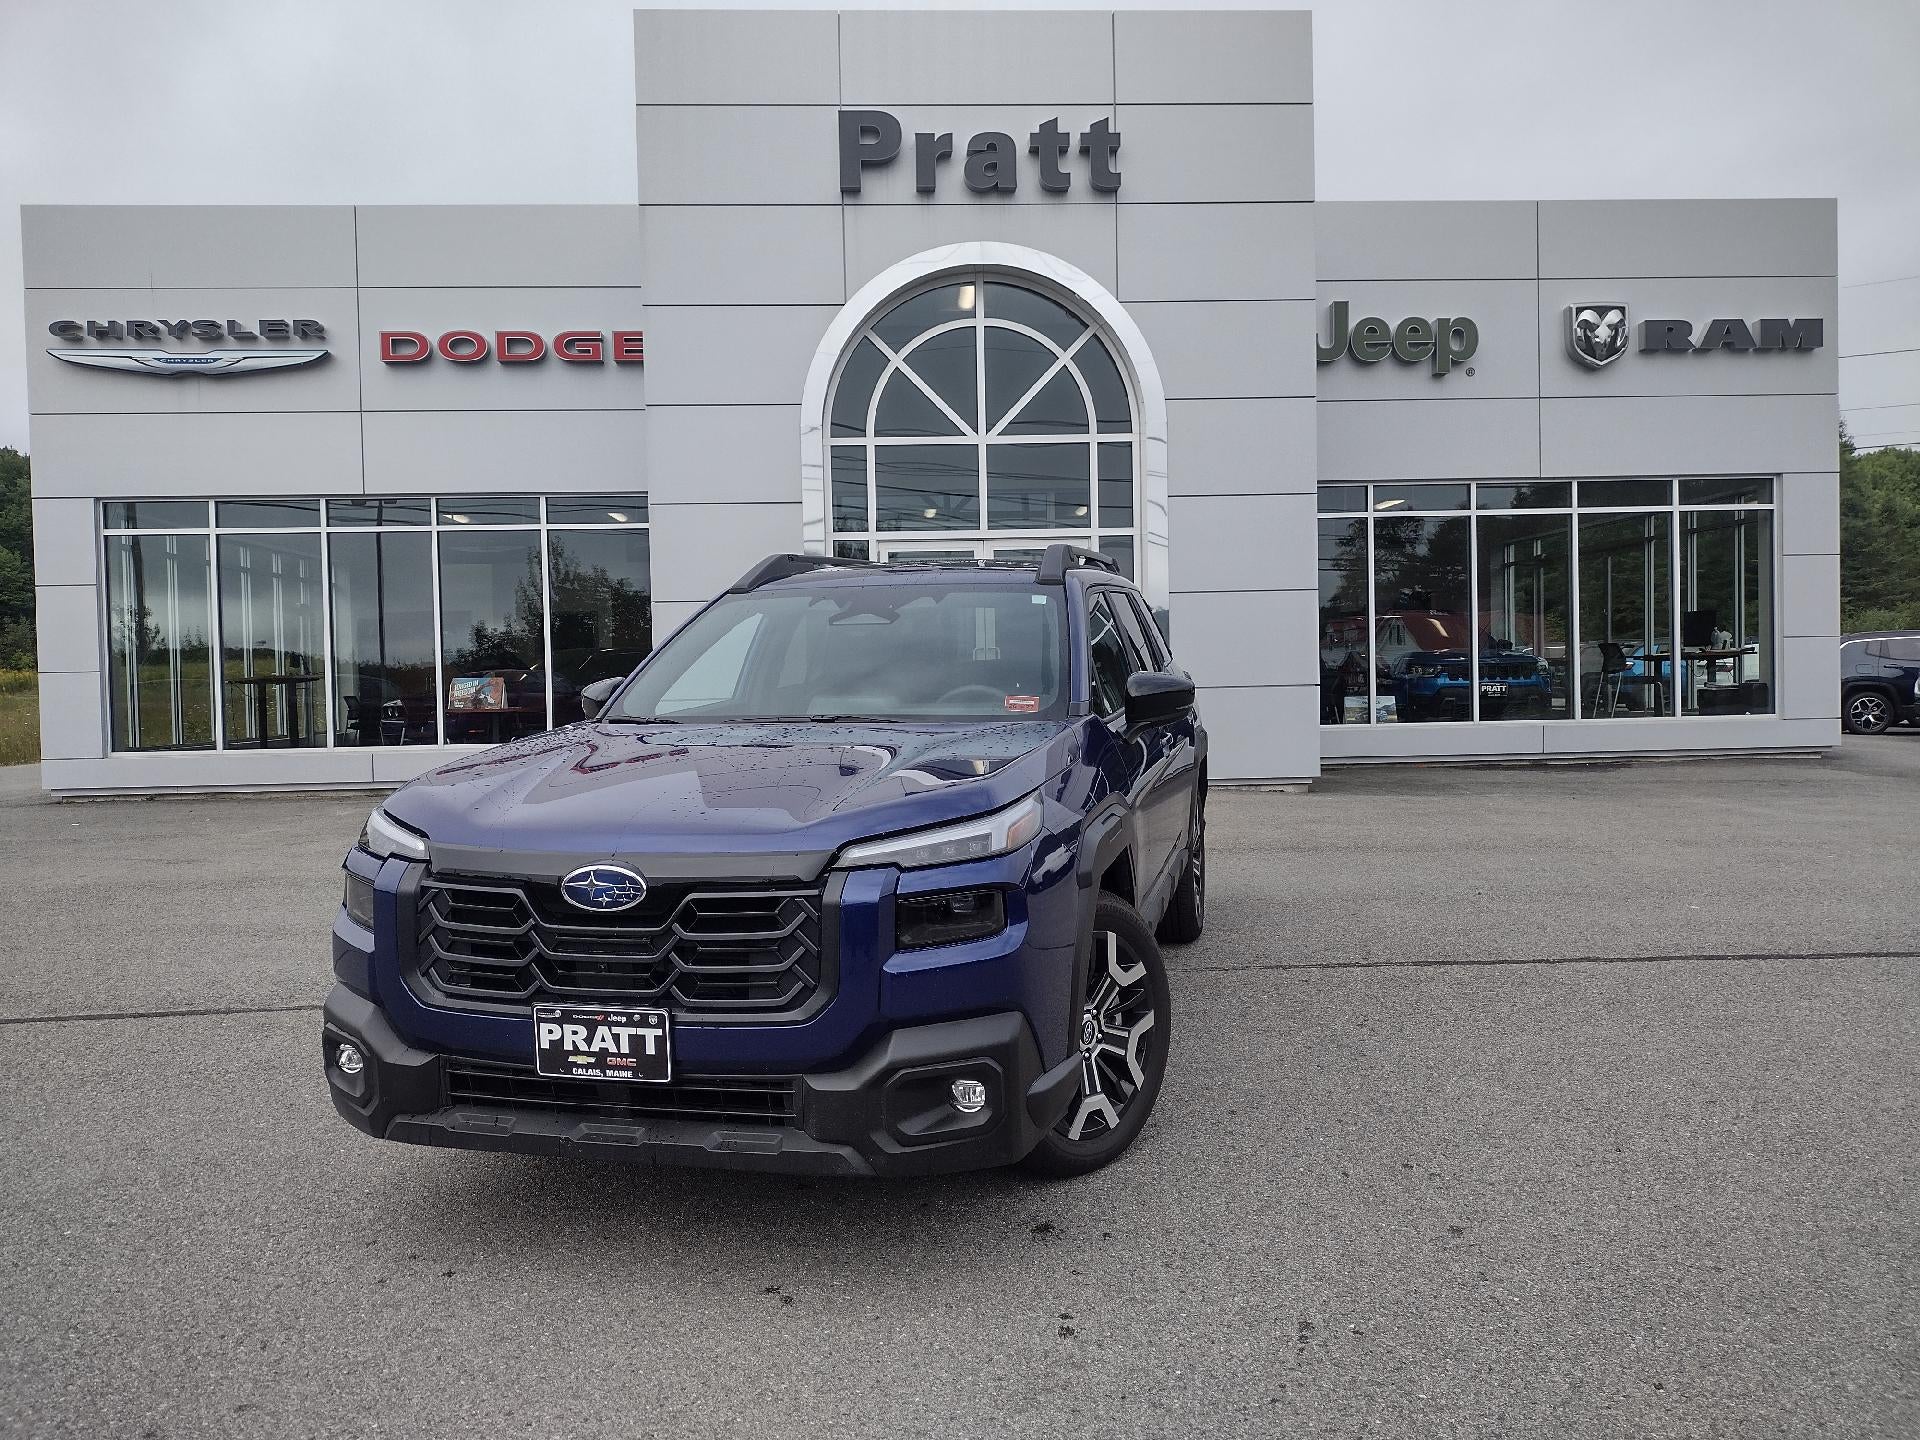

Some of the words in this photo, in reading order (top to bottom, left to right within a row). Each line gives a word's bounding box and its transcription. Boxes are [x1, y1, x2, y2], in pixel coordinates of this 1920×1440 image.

[838, 109, 1122, 193] Pratt
[48, 319, 327, 341] CHRYSLER
[1316, 300, 1479, 376] Jeep
[1638, 318, 1824, 352] RAM
[379, 330, 645, 364] DODGE
[608, 1013, 627, 1024] Jeep
[539, 1022, 663, 1055] PRATT
[572, 1067, 604, 1078] CALAIS,
[605, 1069, 634, 1078] MAINE
[606, 1057, 637, 1067] GMC
